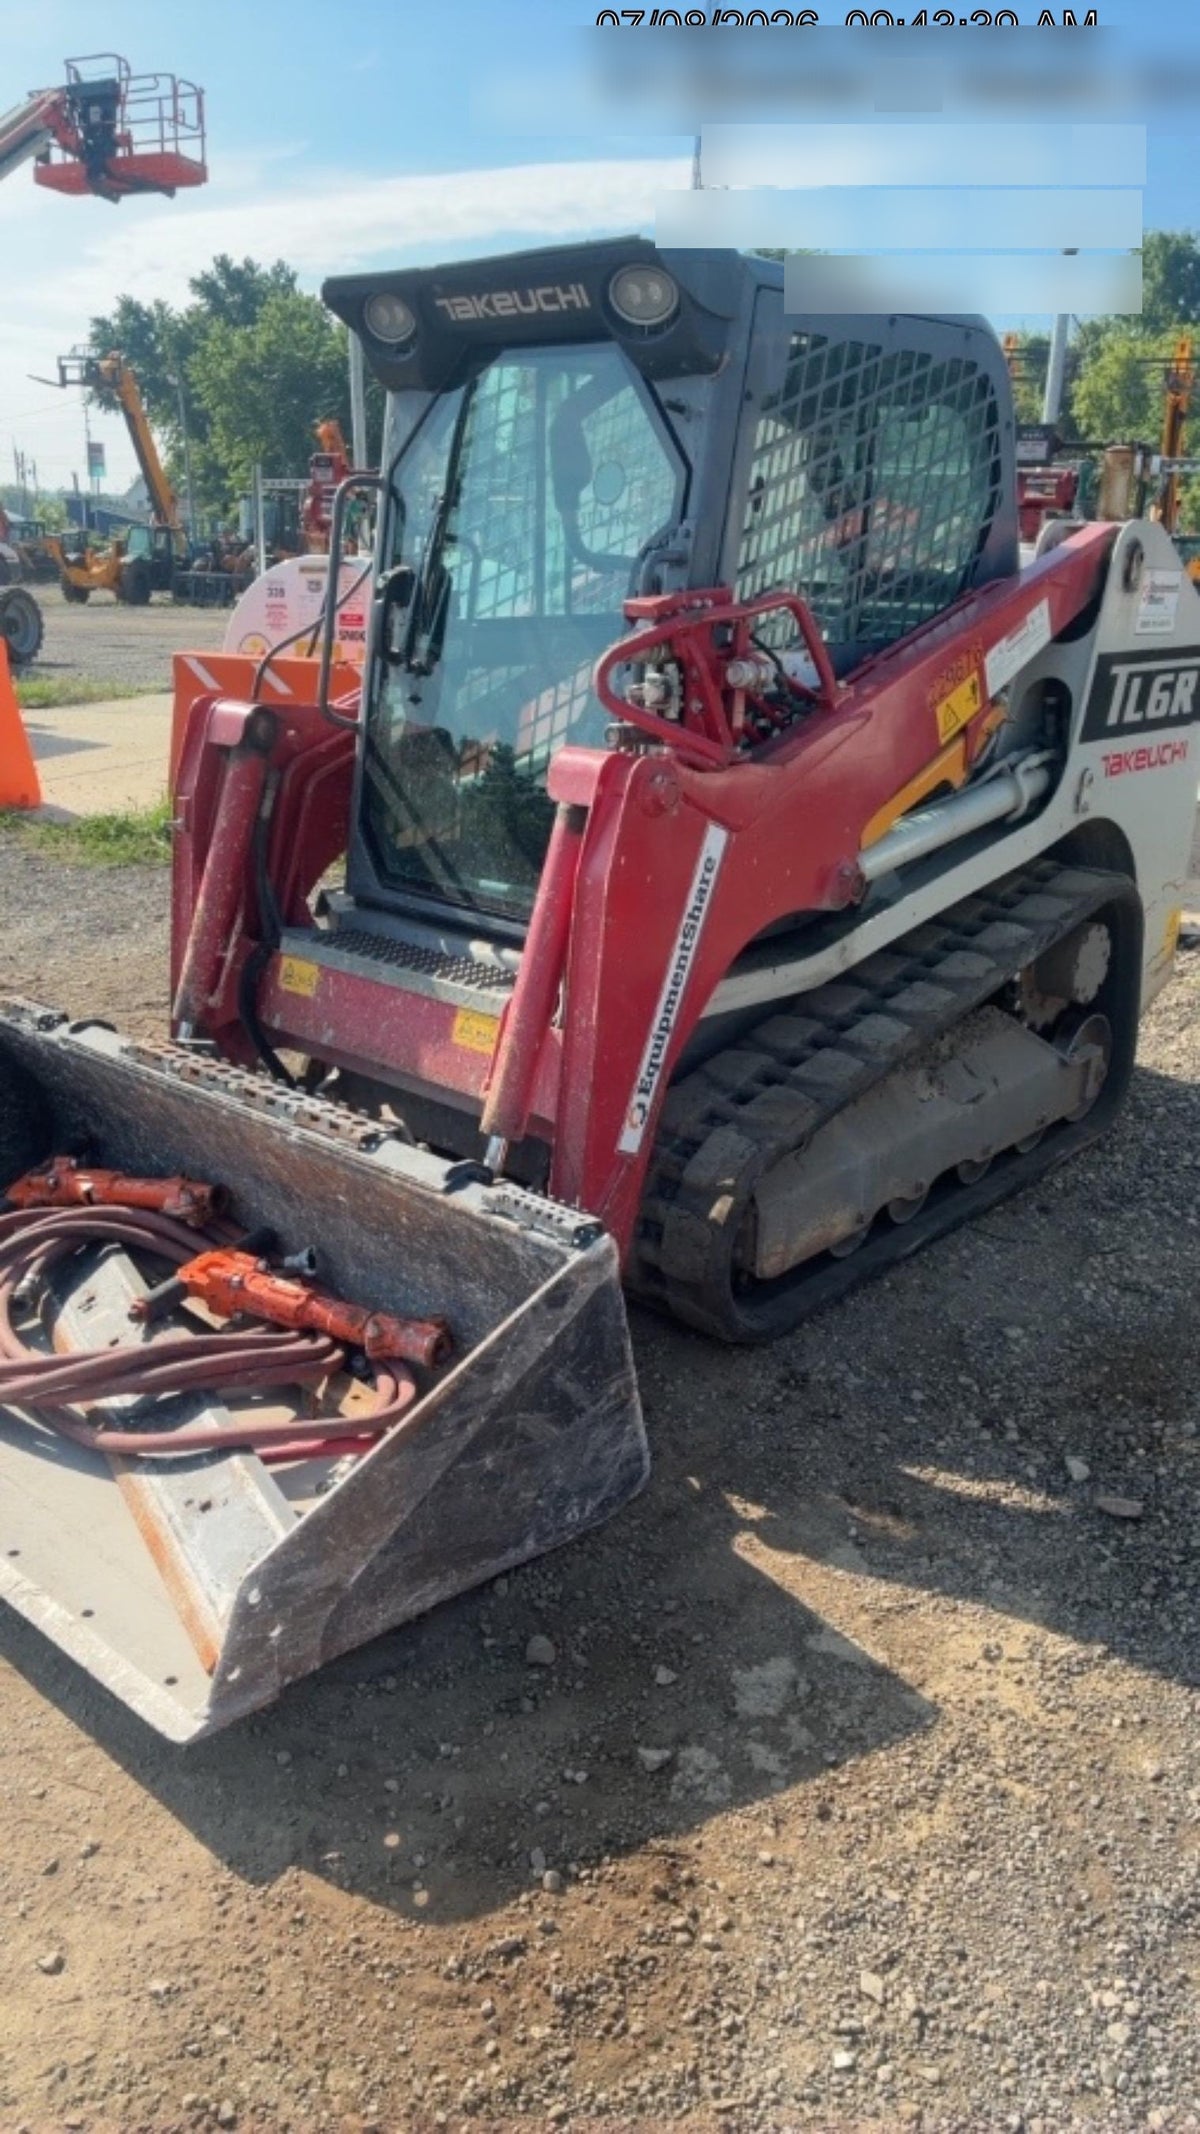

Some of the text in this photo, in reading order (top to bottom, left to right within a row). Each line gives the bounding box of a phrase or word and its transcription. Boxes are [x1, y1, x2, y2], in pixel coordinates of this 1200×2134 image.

[435, 283, 591, 320] TAKEUCHI
[1107, 656, 1200, 726] TL6R
[1102, 740, 1188, 777] TAKEUCHI
[637, 856, 717, 1097] EquipmentShare
